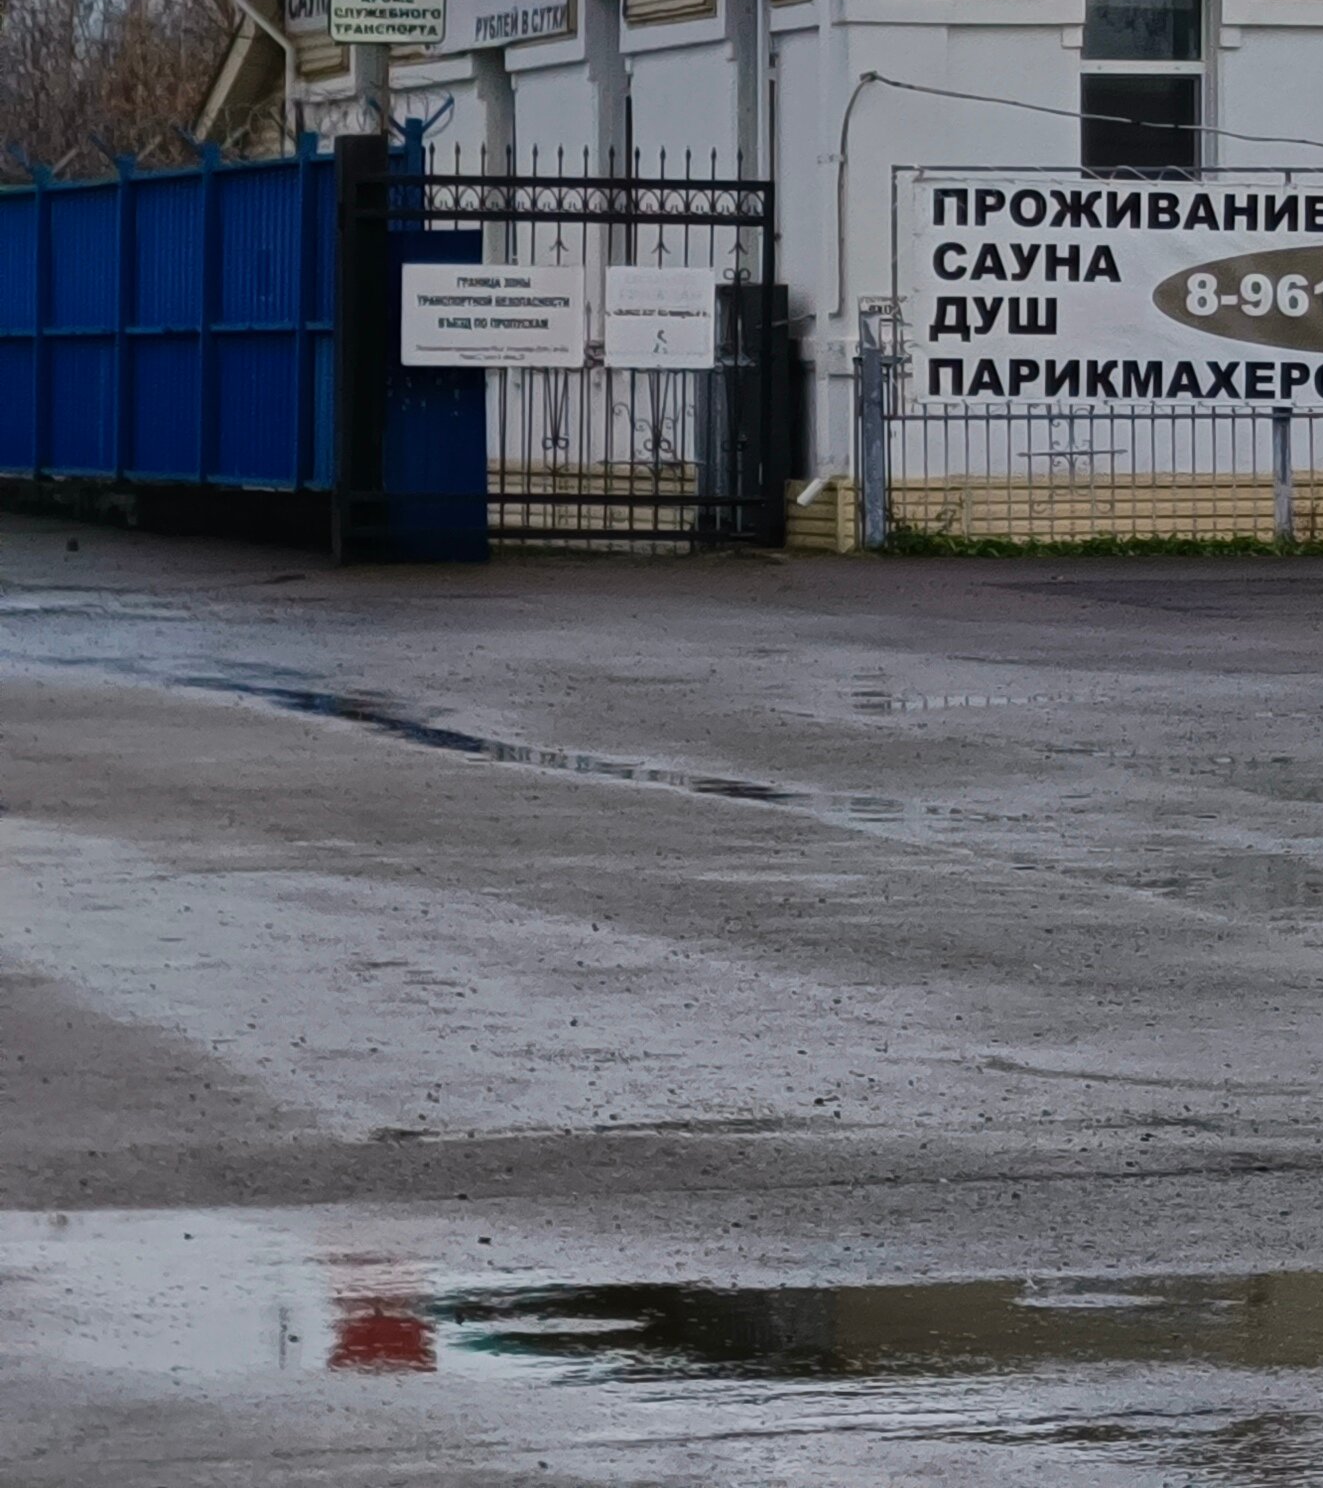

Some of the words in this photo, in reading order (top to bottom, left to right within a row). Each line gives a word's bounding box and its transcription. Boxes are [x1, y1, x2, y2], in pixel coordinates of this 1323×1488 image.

[334, 7, 441, 19] СЛУЖЕБНОГО
[334, 23, 438, 36] ТРАНСПОРТА
[475, 7, 518, 42] РУБЛЕЙ
[521, 10, 529, 35] В
[531, 4, 568, 33] СУТКИ
[932, 242, 1122, 283] САУНА
[929, 296, 1058, 342] ДУШ
